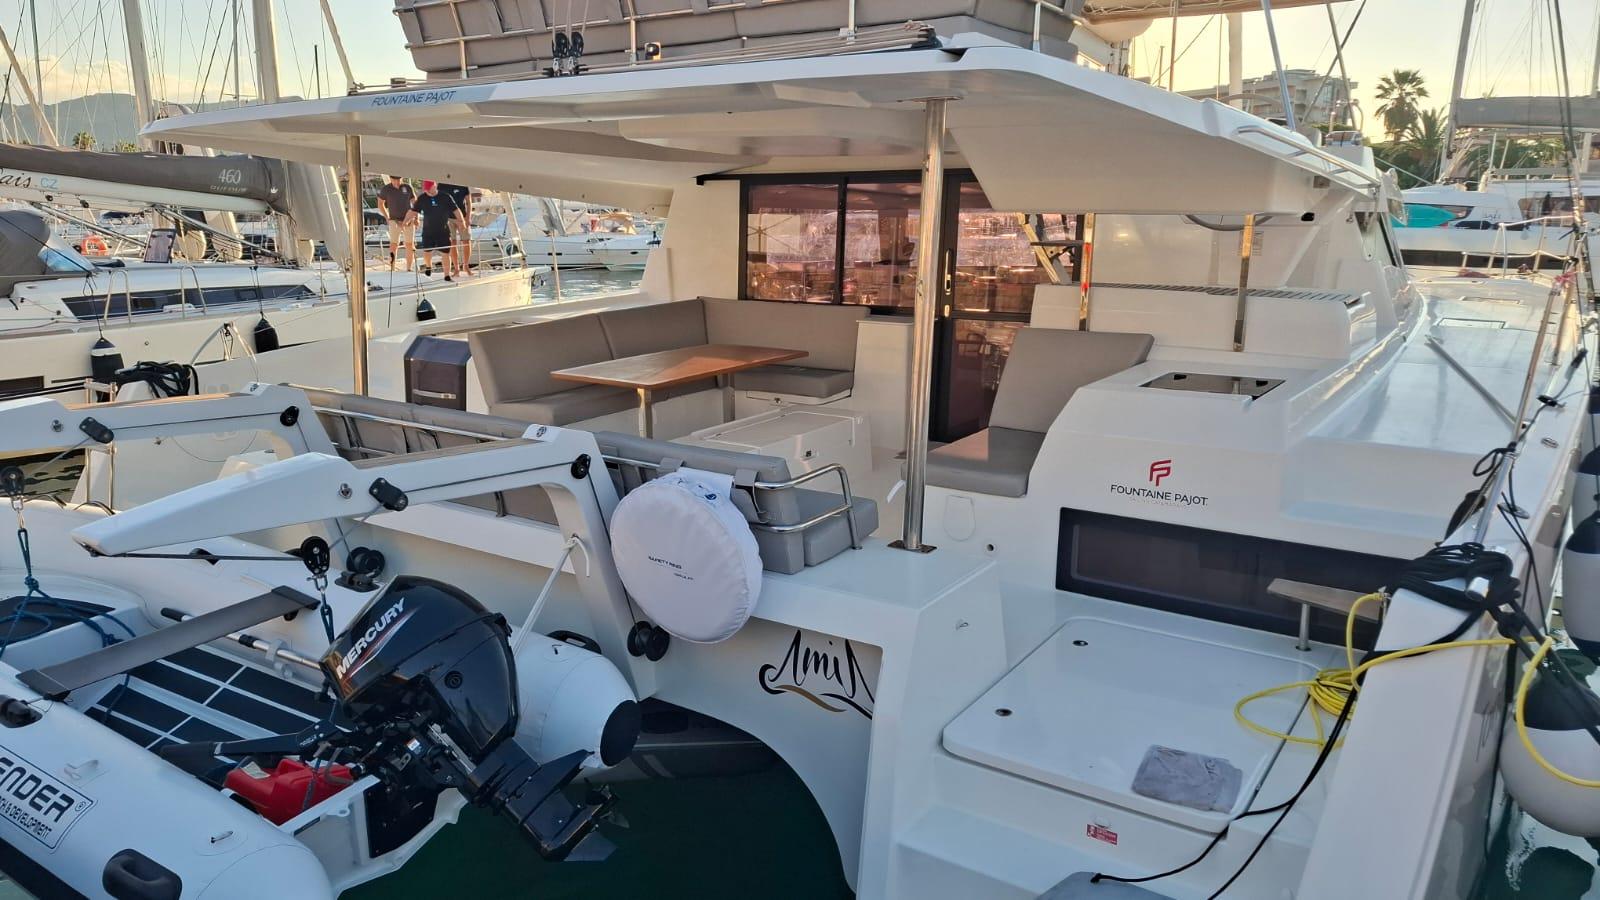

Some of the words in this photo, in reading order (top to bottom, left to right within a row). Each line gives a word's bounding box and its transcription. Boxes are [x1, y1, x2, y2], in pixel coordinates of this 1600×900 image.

[371, 94, 424, 106] FOUNTAINE
[425, 90, 456, 103] PAJOT
[218, 168, 242, 184] 460
[1110, 484, 1172, 501] FOUNTAINE
[1174, 493, 1209, 506] PAJOT
[336, 597, 405, 679] MERCURY
